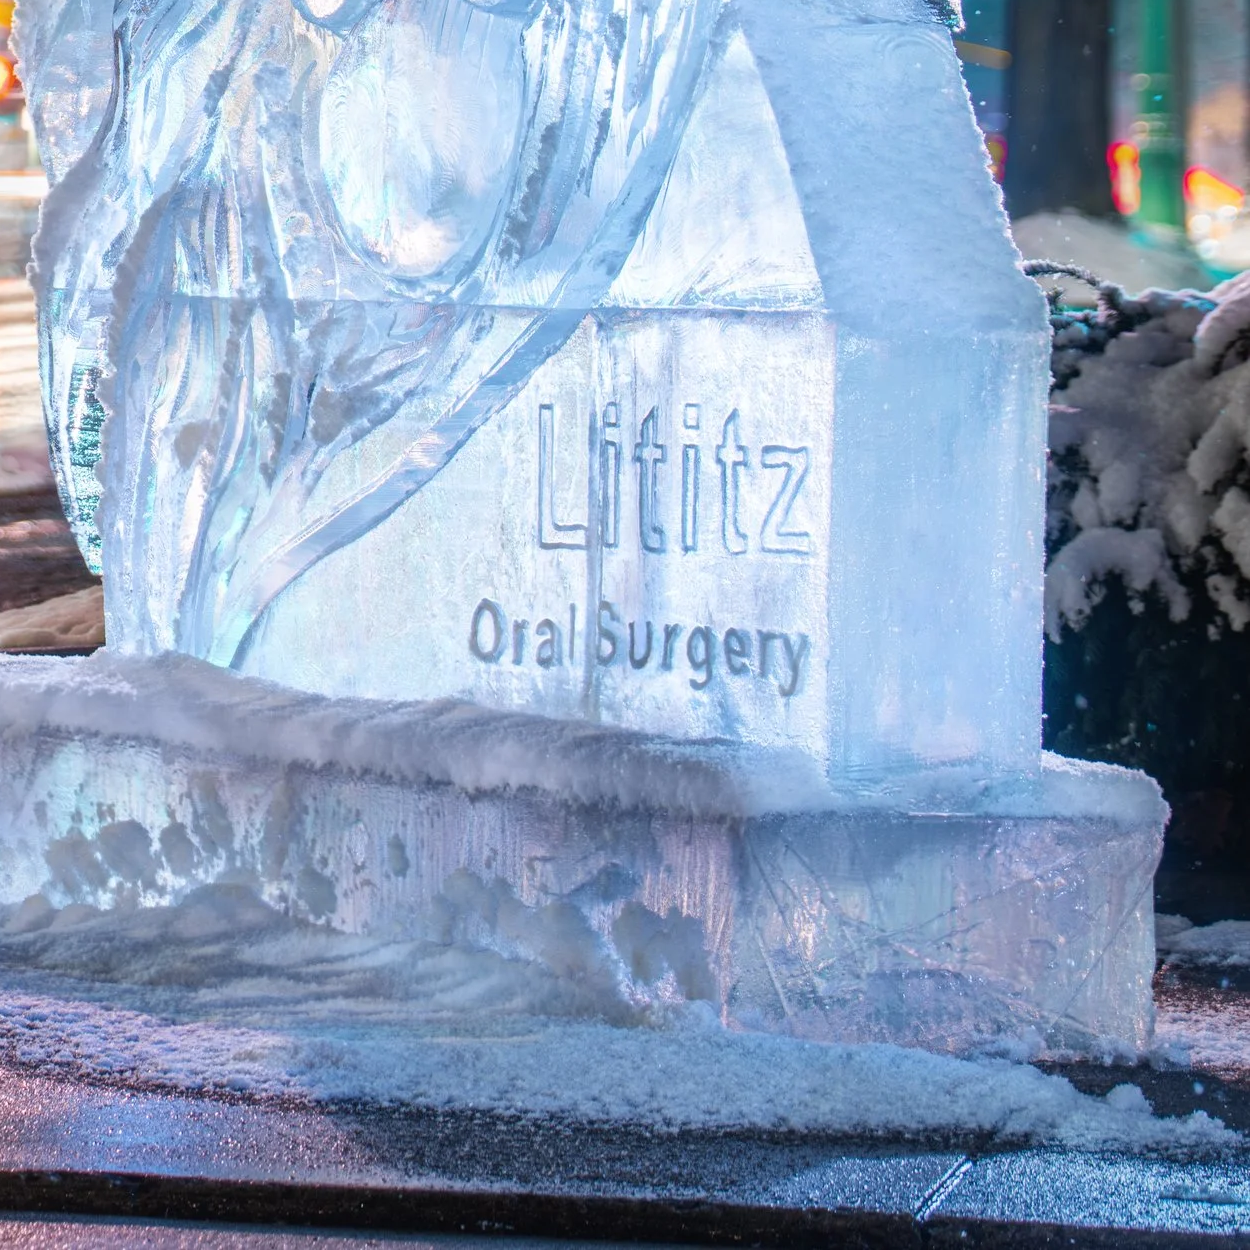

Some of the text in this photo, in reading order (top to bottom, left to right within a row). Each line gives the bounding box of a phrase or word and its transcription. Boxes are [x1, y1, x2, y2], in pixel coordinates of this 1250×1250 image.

[538, 401, 810, 555] Lititz
[468, 597, 811, 698] Oral Surgery
